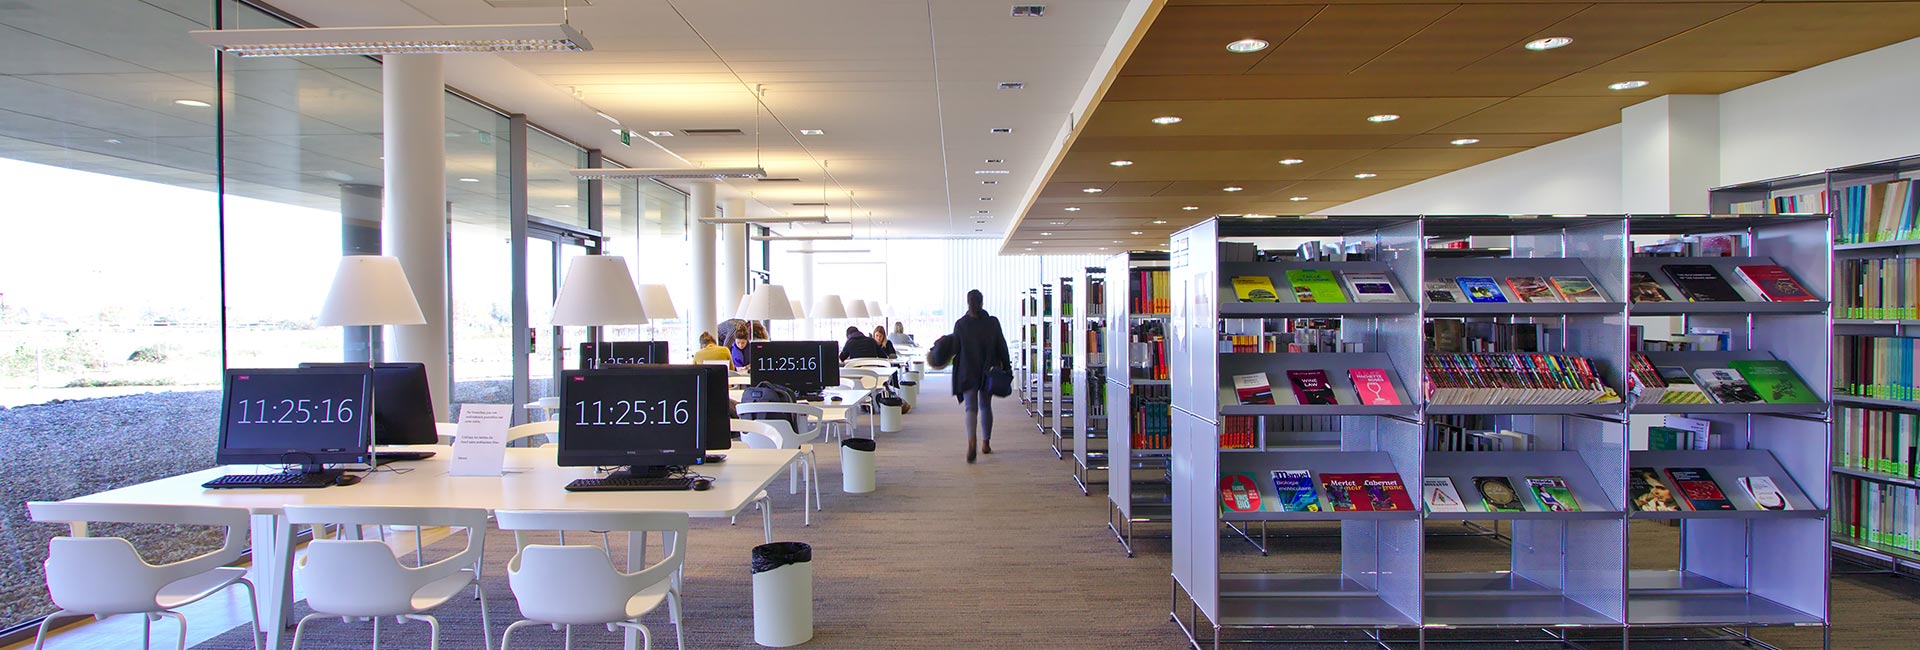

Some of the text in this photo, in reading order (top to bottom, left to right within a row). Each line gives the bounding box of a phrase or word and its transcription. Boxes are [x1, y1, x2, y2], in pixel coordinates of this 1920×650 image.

[587, 357, 645, 369] 1:25:16
[758, 356, 817, 371] 11:25:16
[237, 398, 353, 424] 11:25:16
[575, 399, 689, 426] 11:25:16
